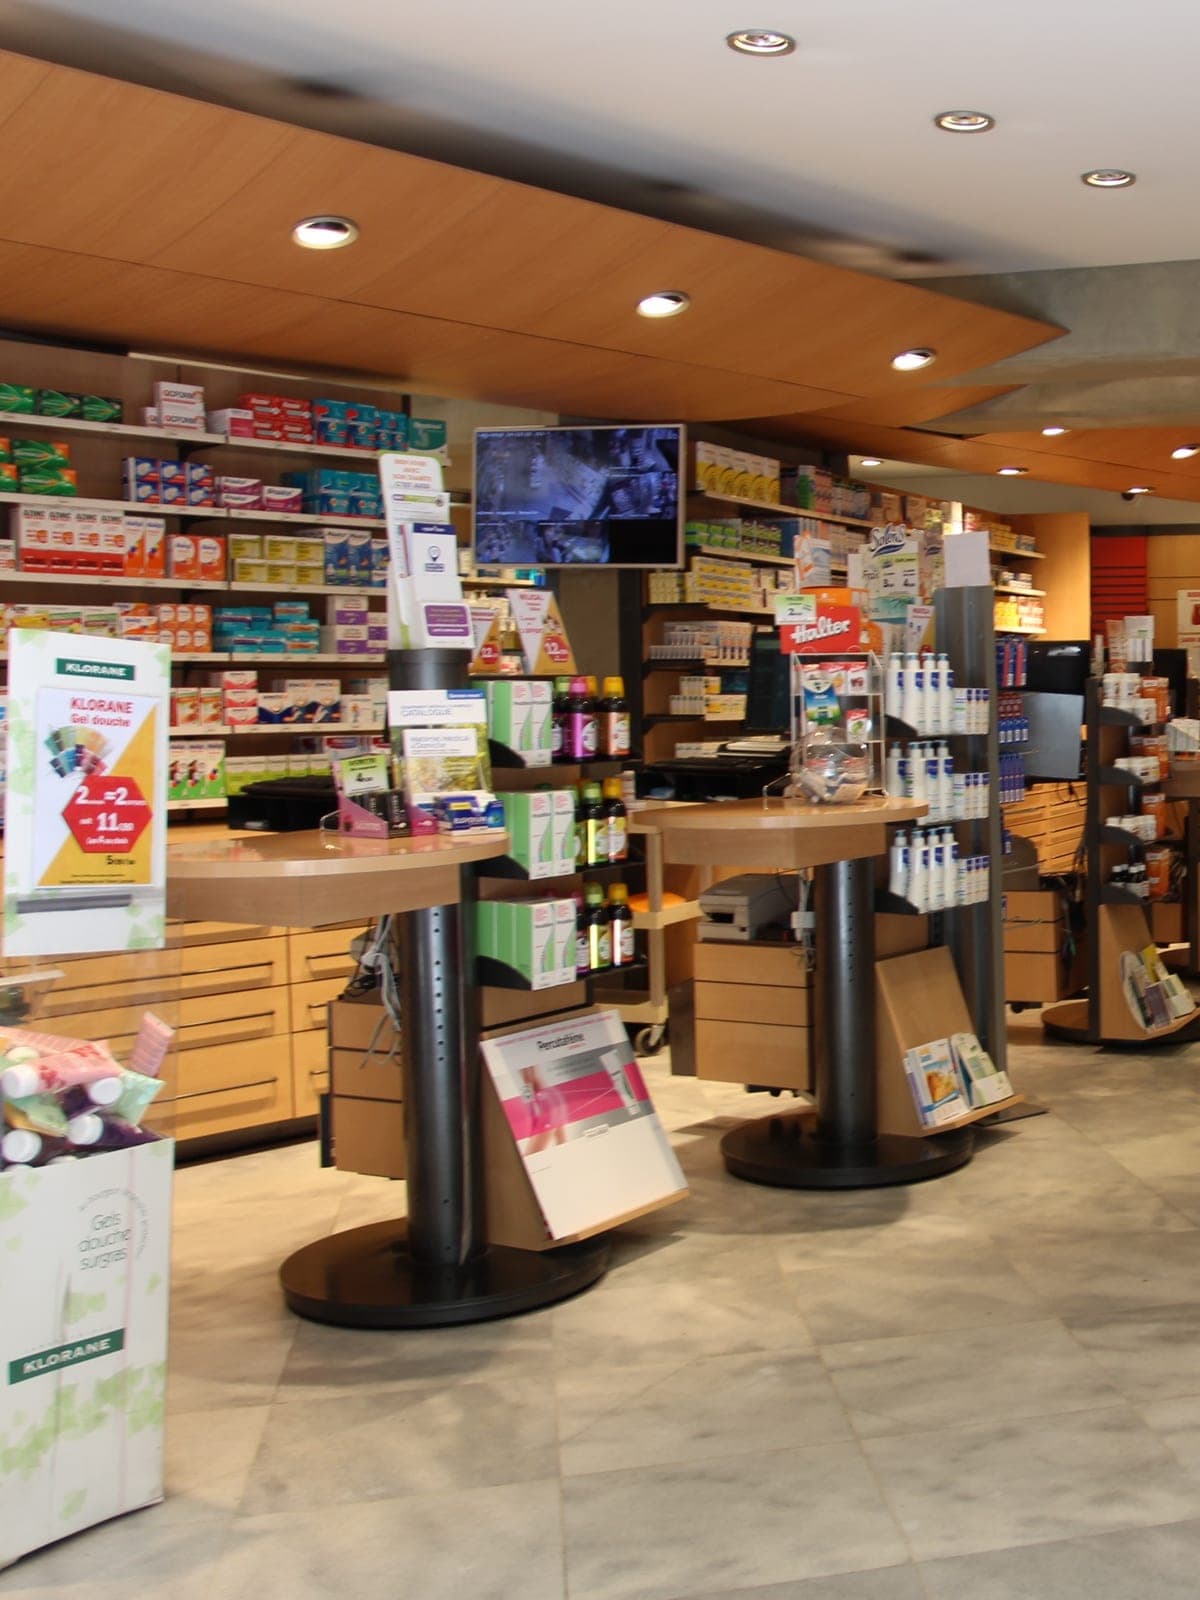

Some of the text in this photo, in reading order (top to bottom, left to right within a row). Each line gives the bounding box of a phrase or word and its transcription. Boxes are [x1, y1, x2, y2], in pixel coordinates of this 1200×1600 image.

[790, 615, 851, 644] Halter
[65, 663, 127, 677] KLORANE
[70, 697, 134, 713] KLORANE
[70, 713, 131, 727] Gel douche
[92, 1213, 122, 1231] Gels
[23, 1338, 112, 1374] KLORANE
